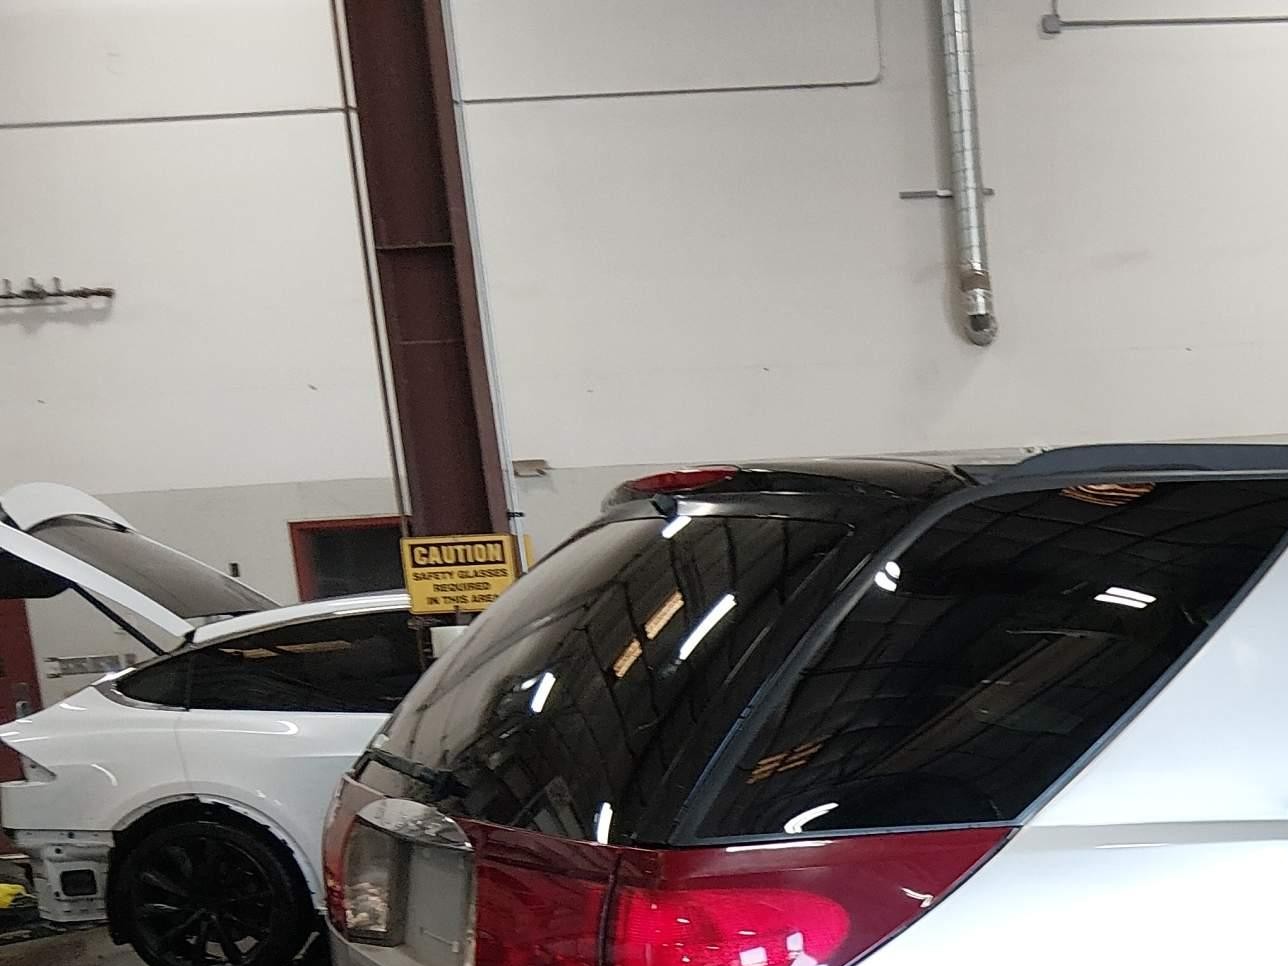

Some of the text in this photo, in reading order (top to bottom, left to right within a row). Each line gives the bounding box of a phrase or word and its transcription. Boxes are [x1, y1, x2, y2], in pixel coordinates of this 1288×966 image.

[413, 543, 503, 565] CAUTION
[412, 568, 508, 581] SAFETY GLASSES
[433, 582, 490, 592] REQUIRED
[427, 596, 441, 605] IN
[443, 595, 470, 605] THIS
